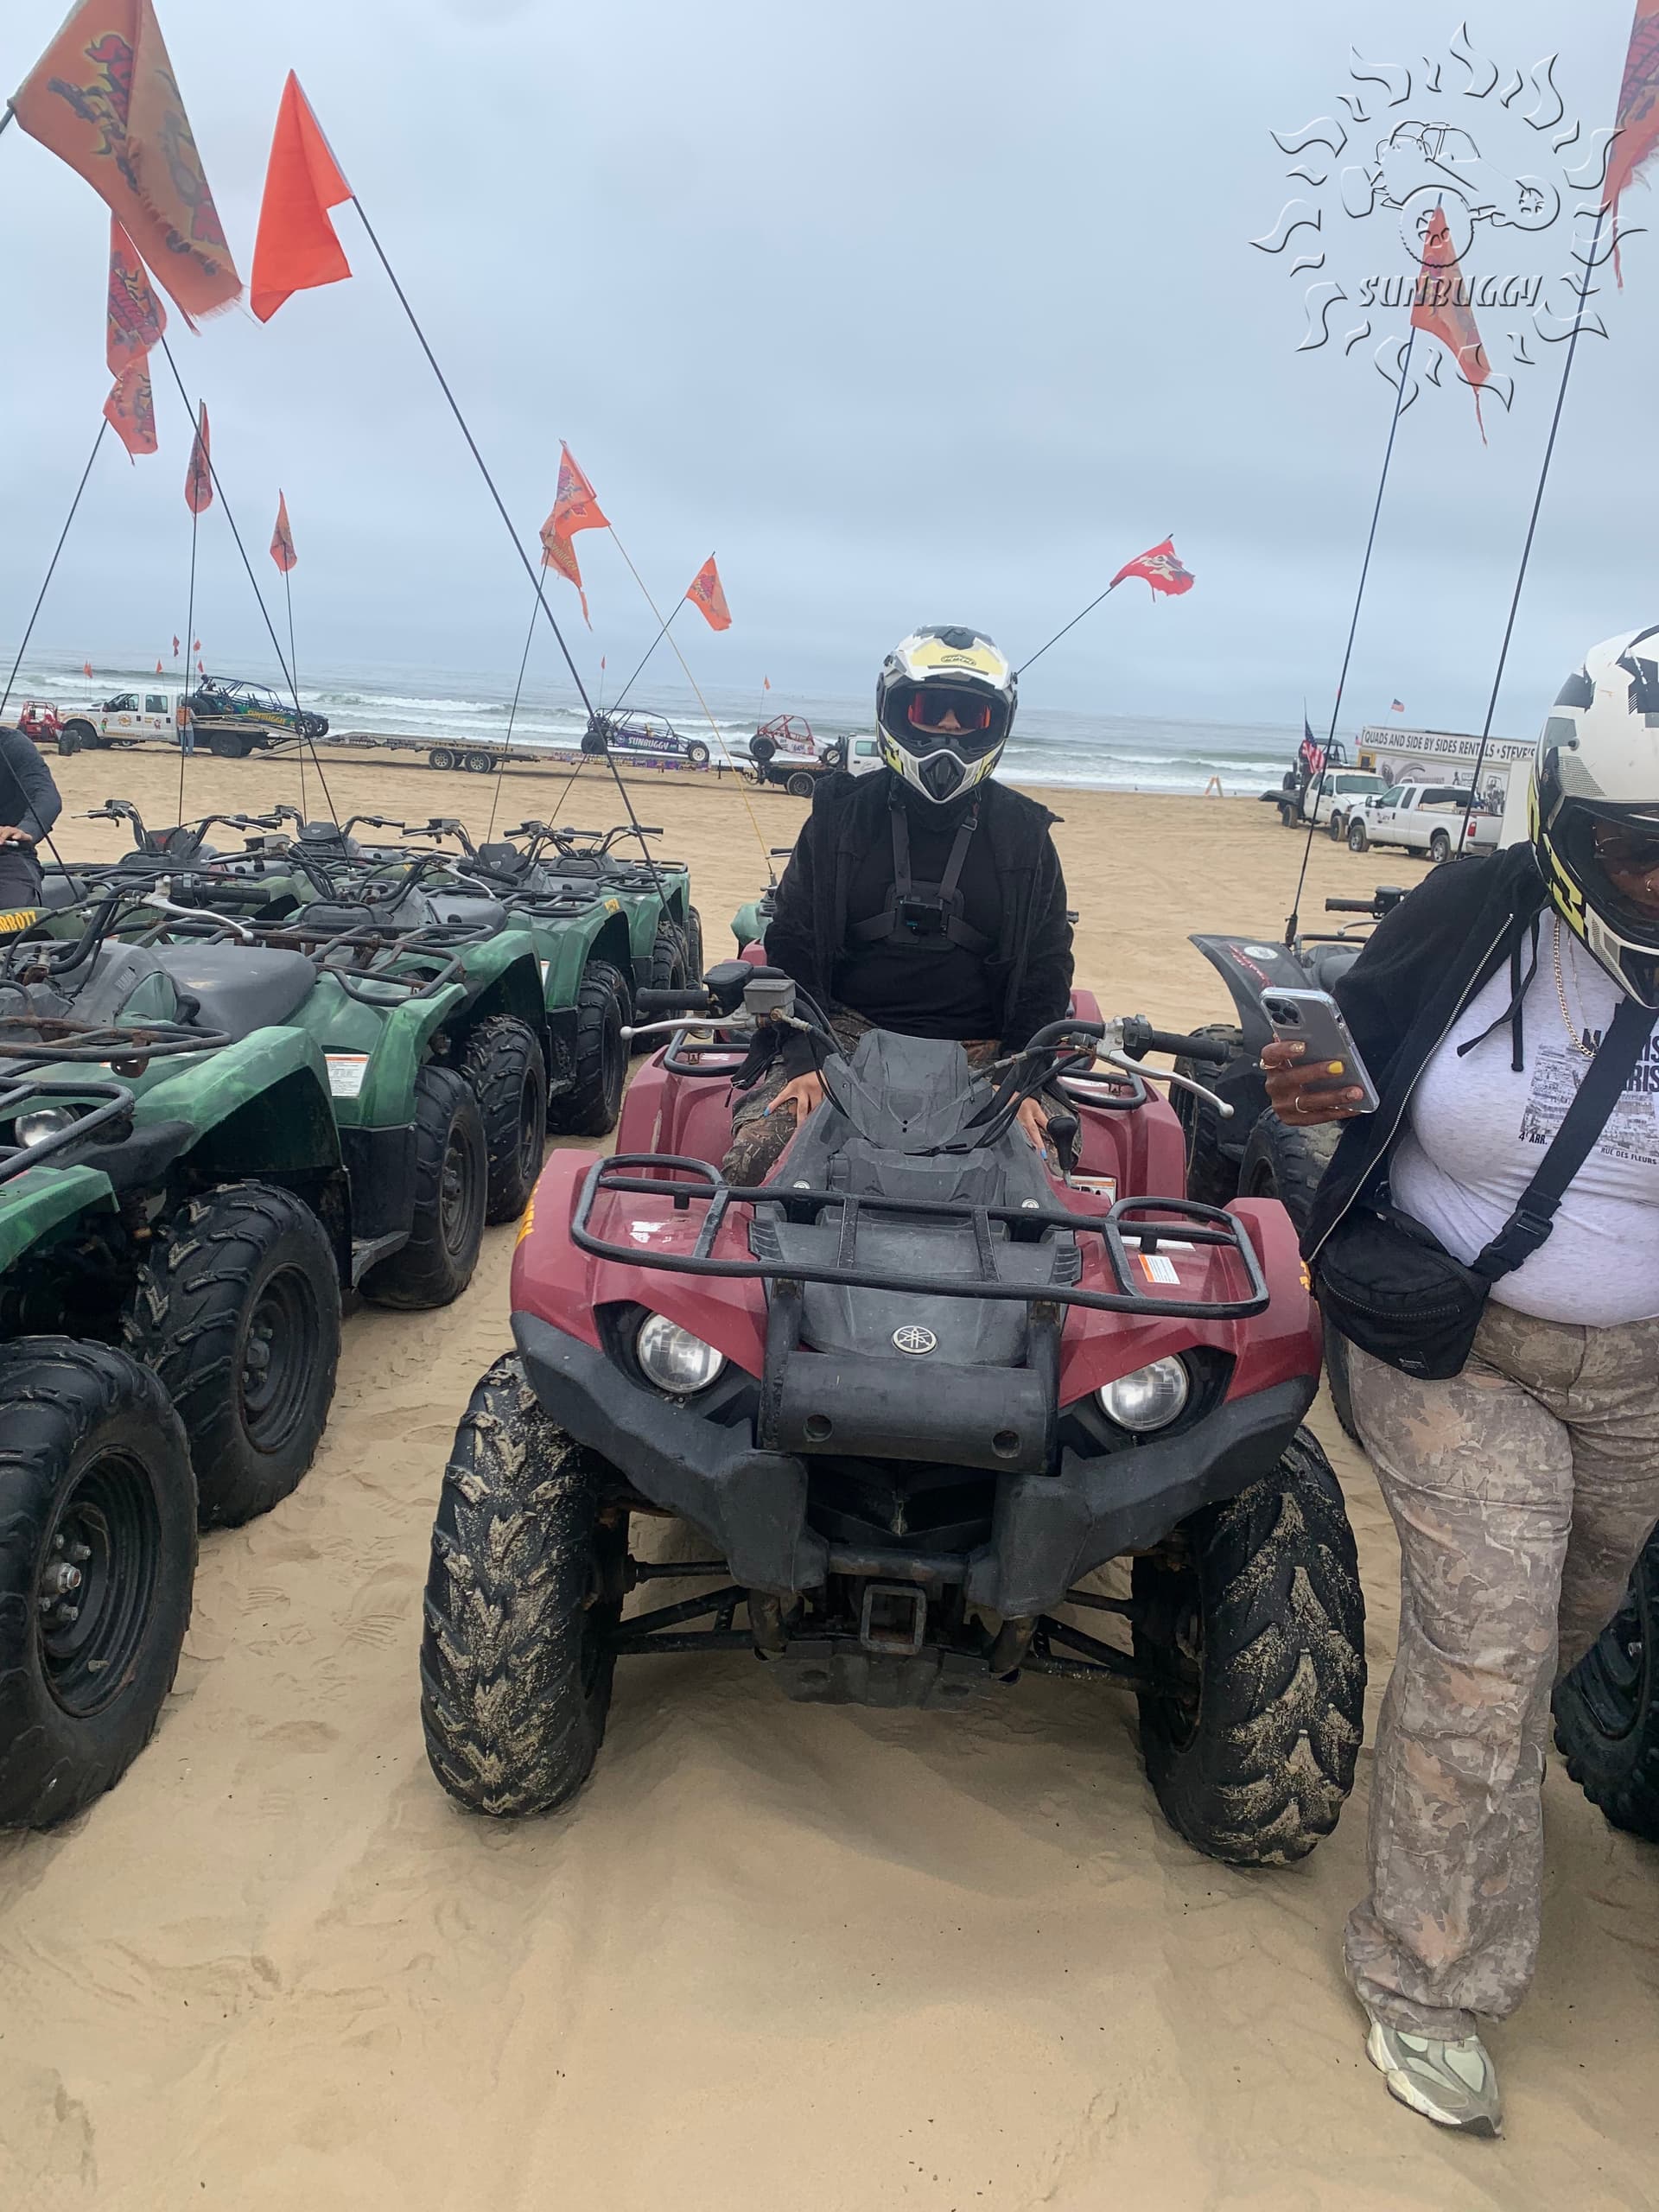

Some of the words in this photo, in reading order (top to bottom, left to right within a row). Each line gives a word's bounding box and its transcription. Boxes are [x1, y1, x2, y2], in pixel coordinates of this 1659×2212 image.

[1365, 731, 1388, 744] QUADS
[1389, 734, 1405, 747] AND
[1406, 735, 1422, 749] SIDE
[1424, 737, 1434, 751] BY
[1435, 739, 1457, 753] SIDES
[1459, 741, 1495, 757] RENTLS
[1600, 1147, 1613, 1155] RUE
[1616, 1150, 1629, 1159] DES
[1631, 1154, 1657, 1165] FLEURS
